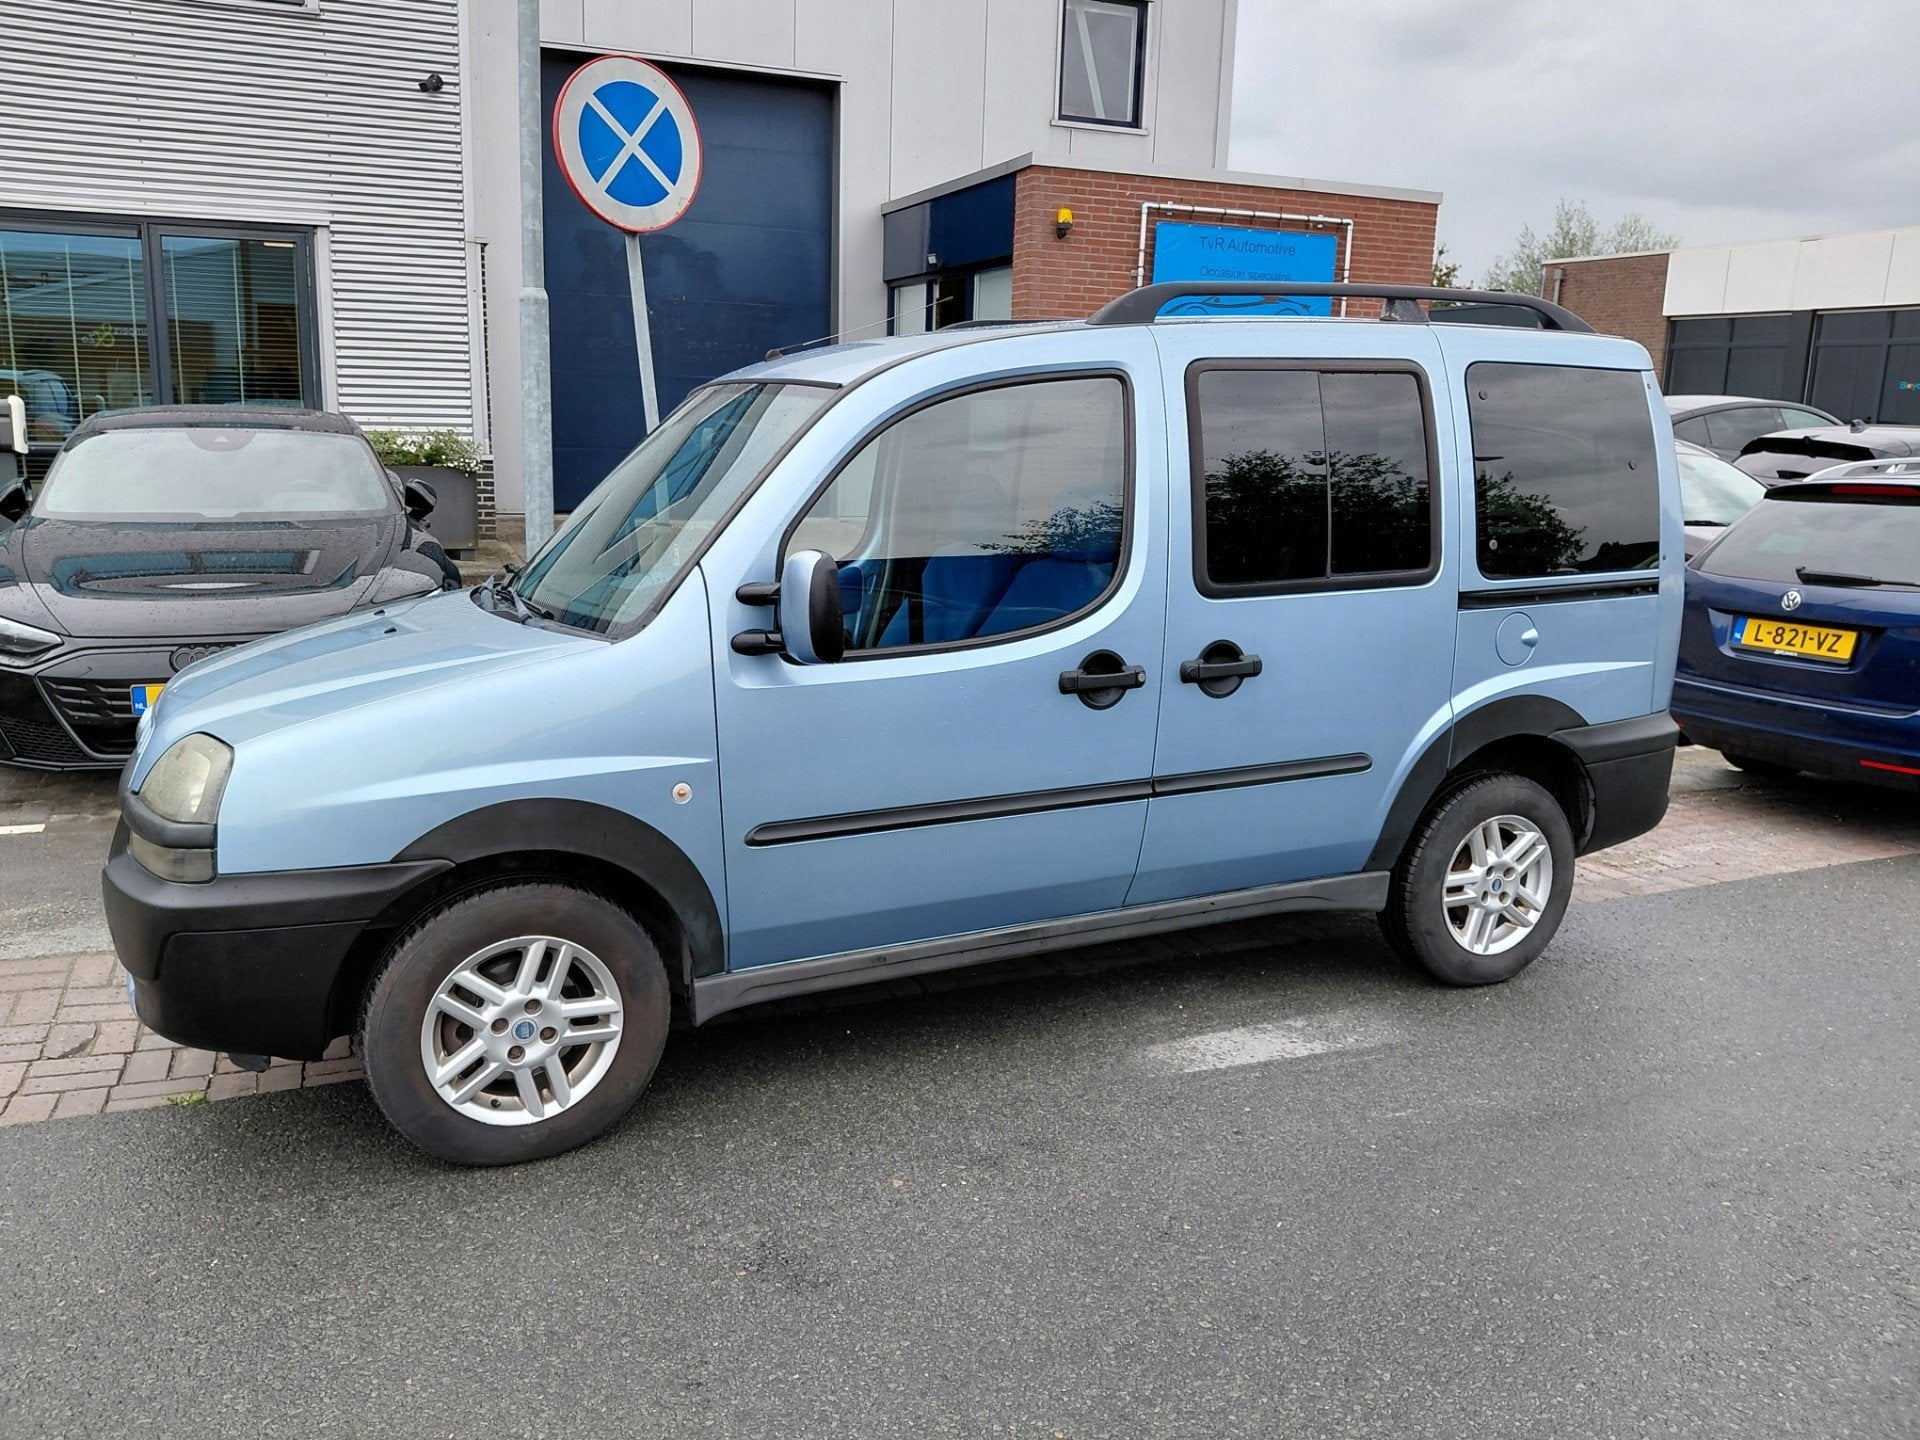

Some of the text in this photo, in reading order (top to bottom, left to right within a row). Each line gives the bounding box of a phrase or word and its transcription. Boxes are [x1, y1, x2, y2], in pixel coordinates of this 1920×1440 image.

[1200, 236, 1296, 256] TvR Automotive
[1200, 265, 1292, 282] Occasion specialist
[1754, 623, 1843, 653] L-821-VZ
